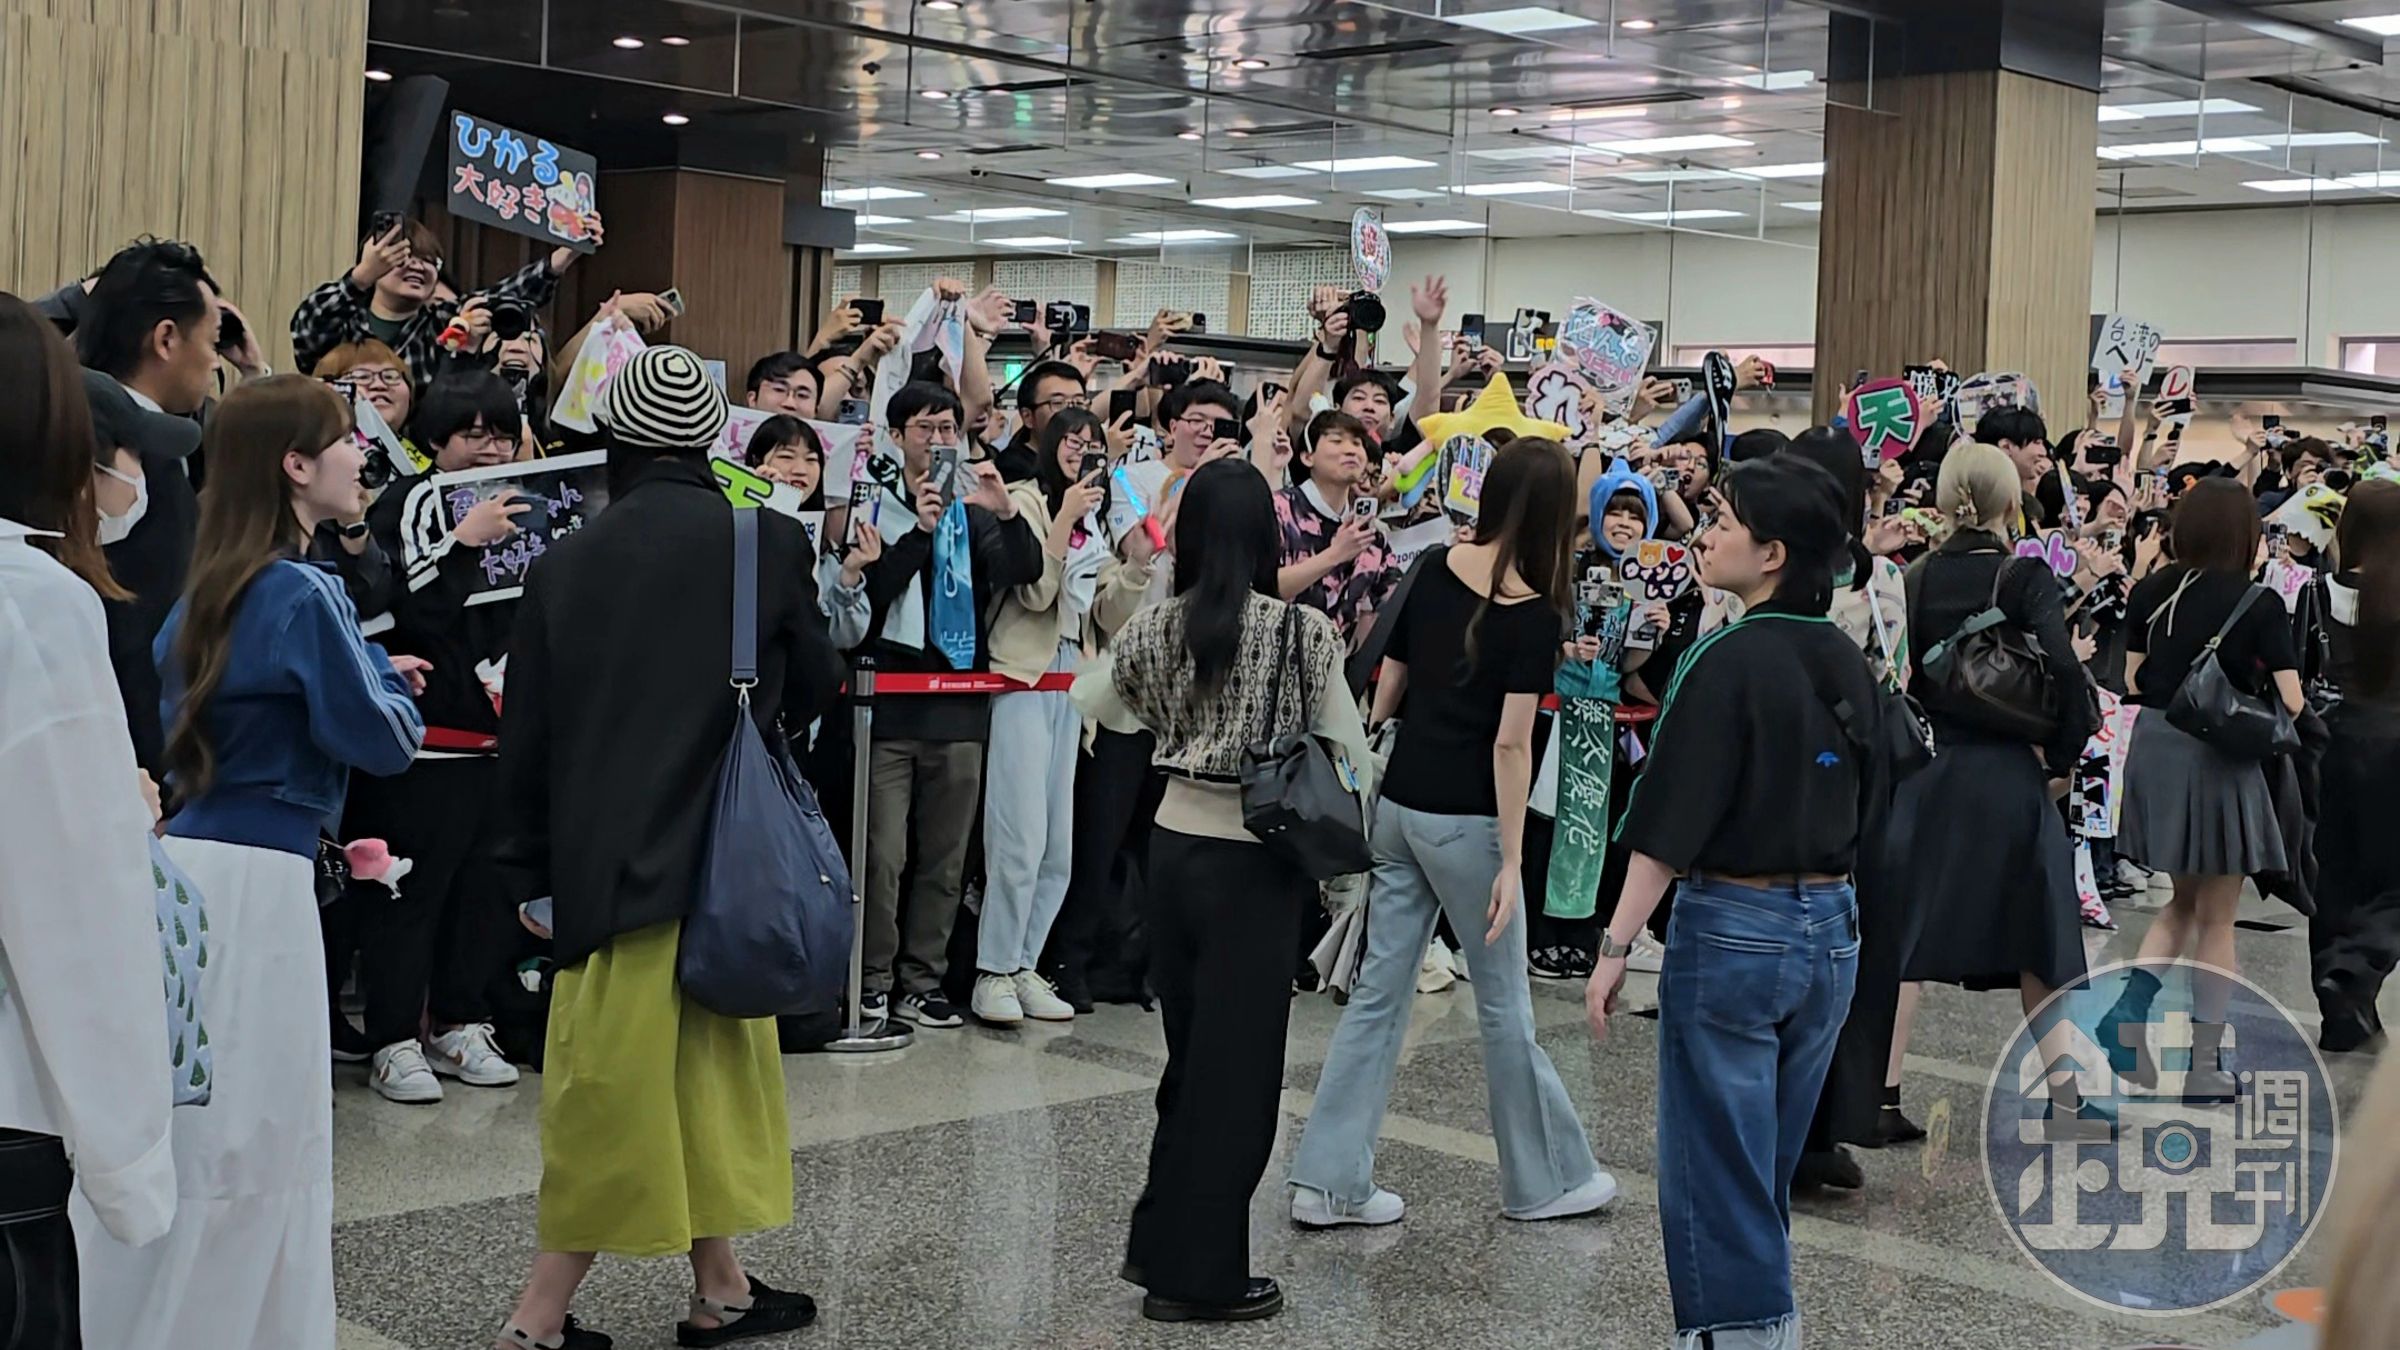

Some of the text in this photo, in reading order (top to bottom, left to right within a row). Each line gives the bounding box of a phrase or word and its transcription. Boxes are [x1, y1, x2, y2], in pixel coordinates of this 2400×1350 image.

[455, 115, 560, 185] ひかる
[453, 163, 547, 225] 大好き
[2110, 317, 2161, 352] 台湾の
[1856, 385, 1914, 448] 天
